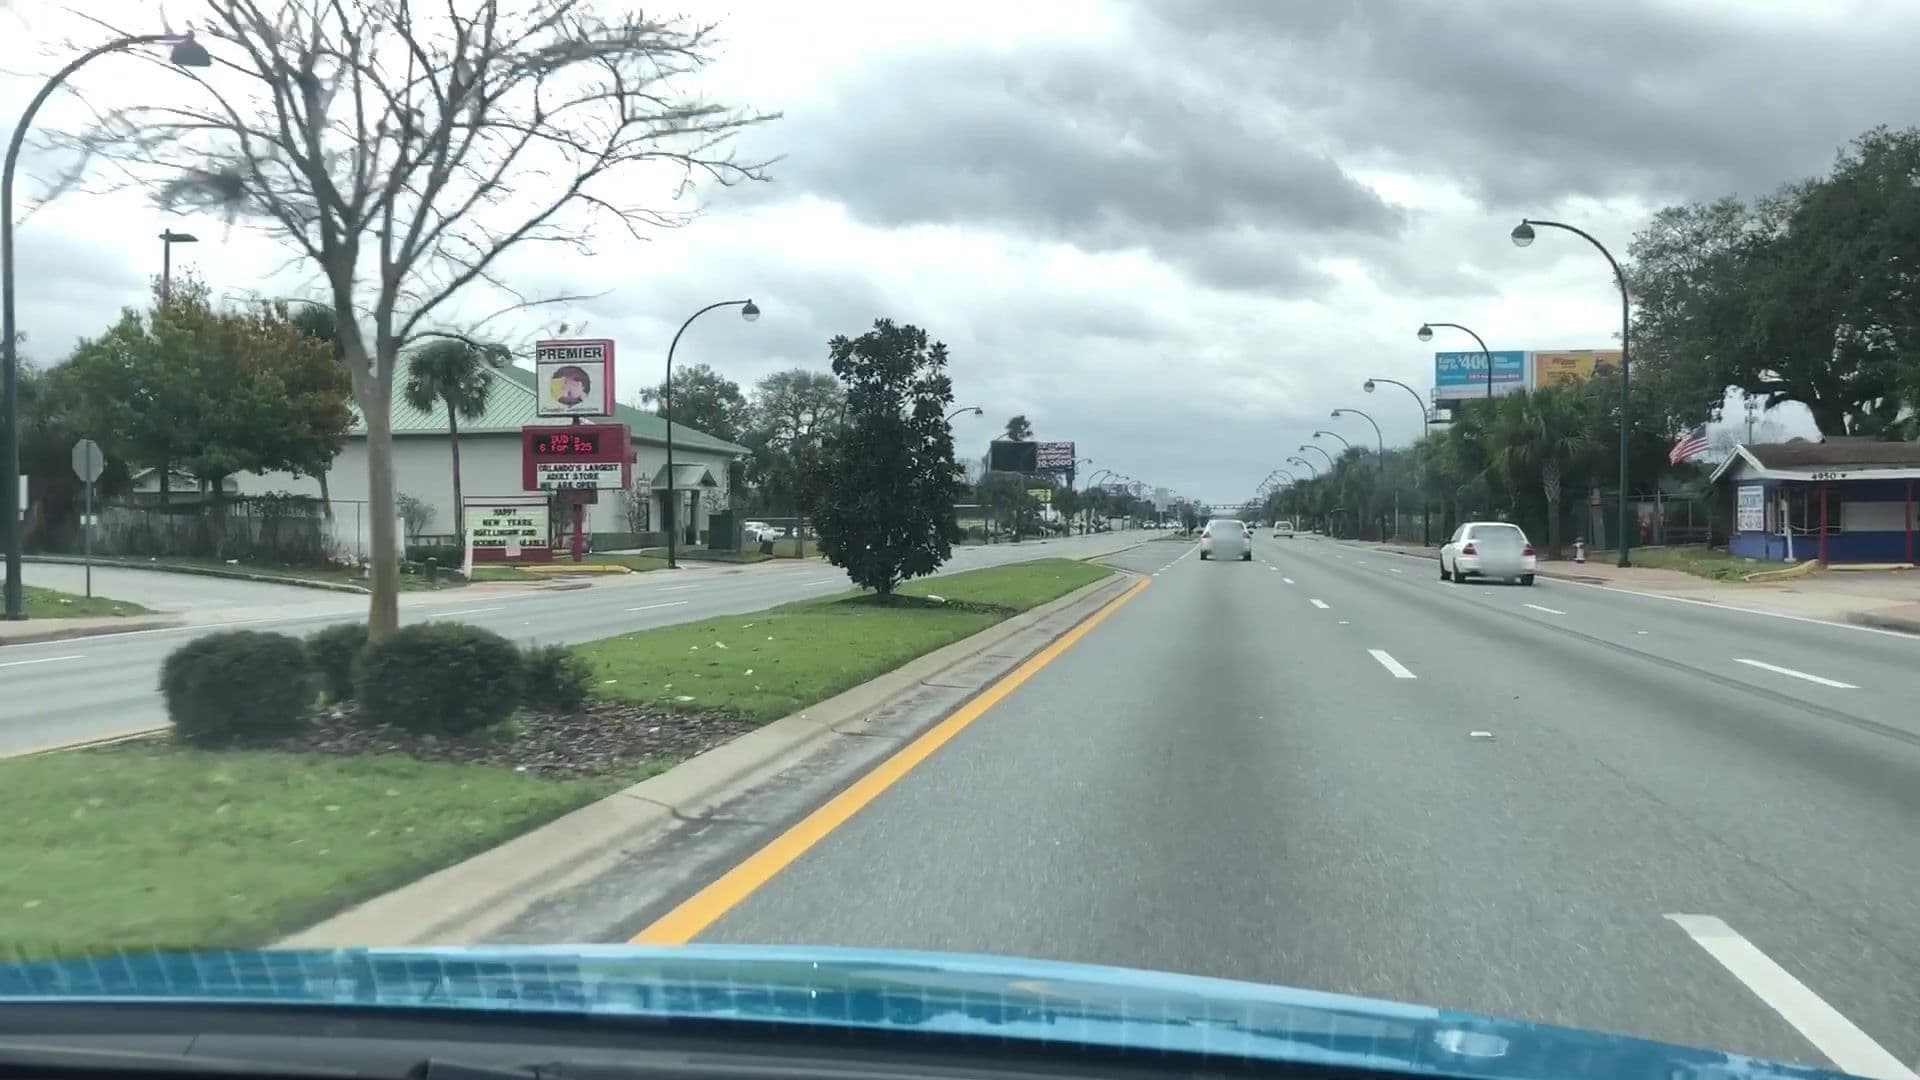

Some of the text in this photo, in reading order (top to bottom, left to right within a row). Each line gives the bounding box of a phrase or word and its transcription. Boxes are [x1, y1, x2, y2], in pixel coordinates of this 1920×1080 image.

[539, 347, 602, 360] PREMIER
[546, 472, 600, 480] ADULT STORE
[493, 508, 517, 516] HAPPY
